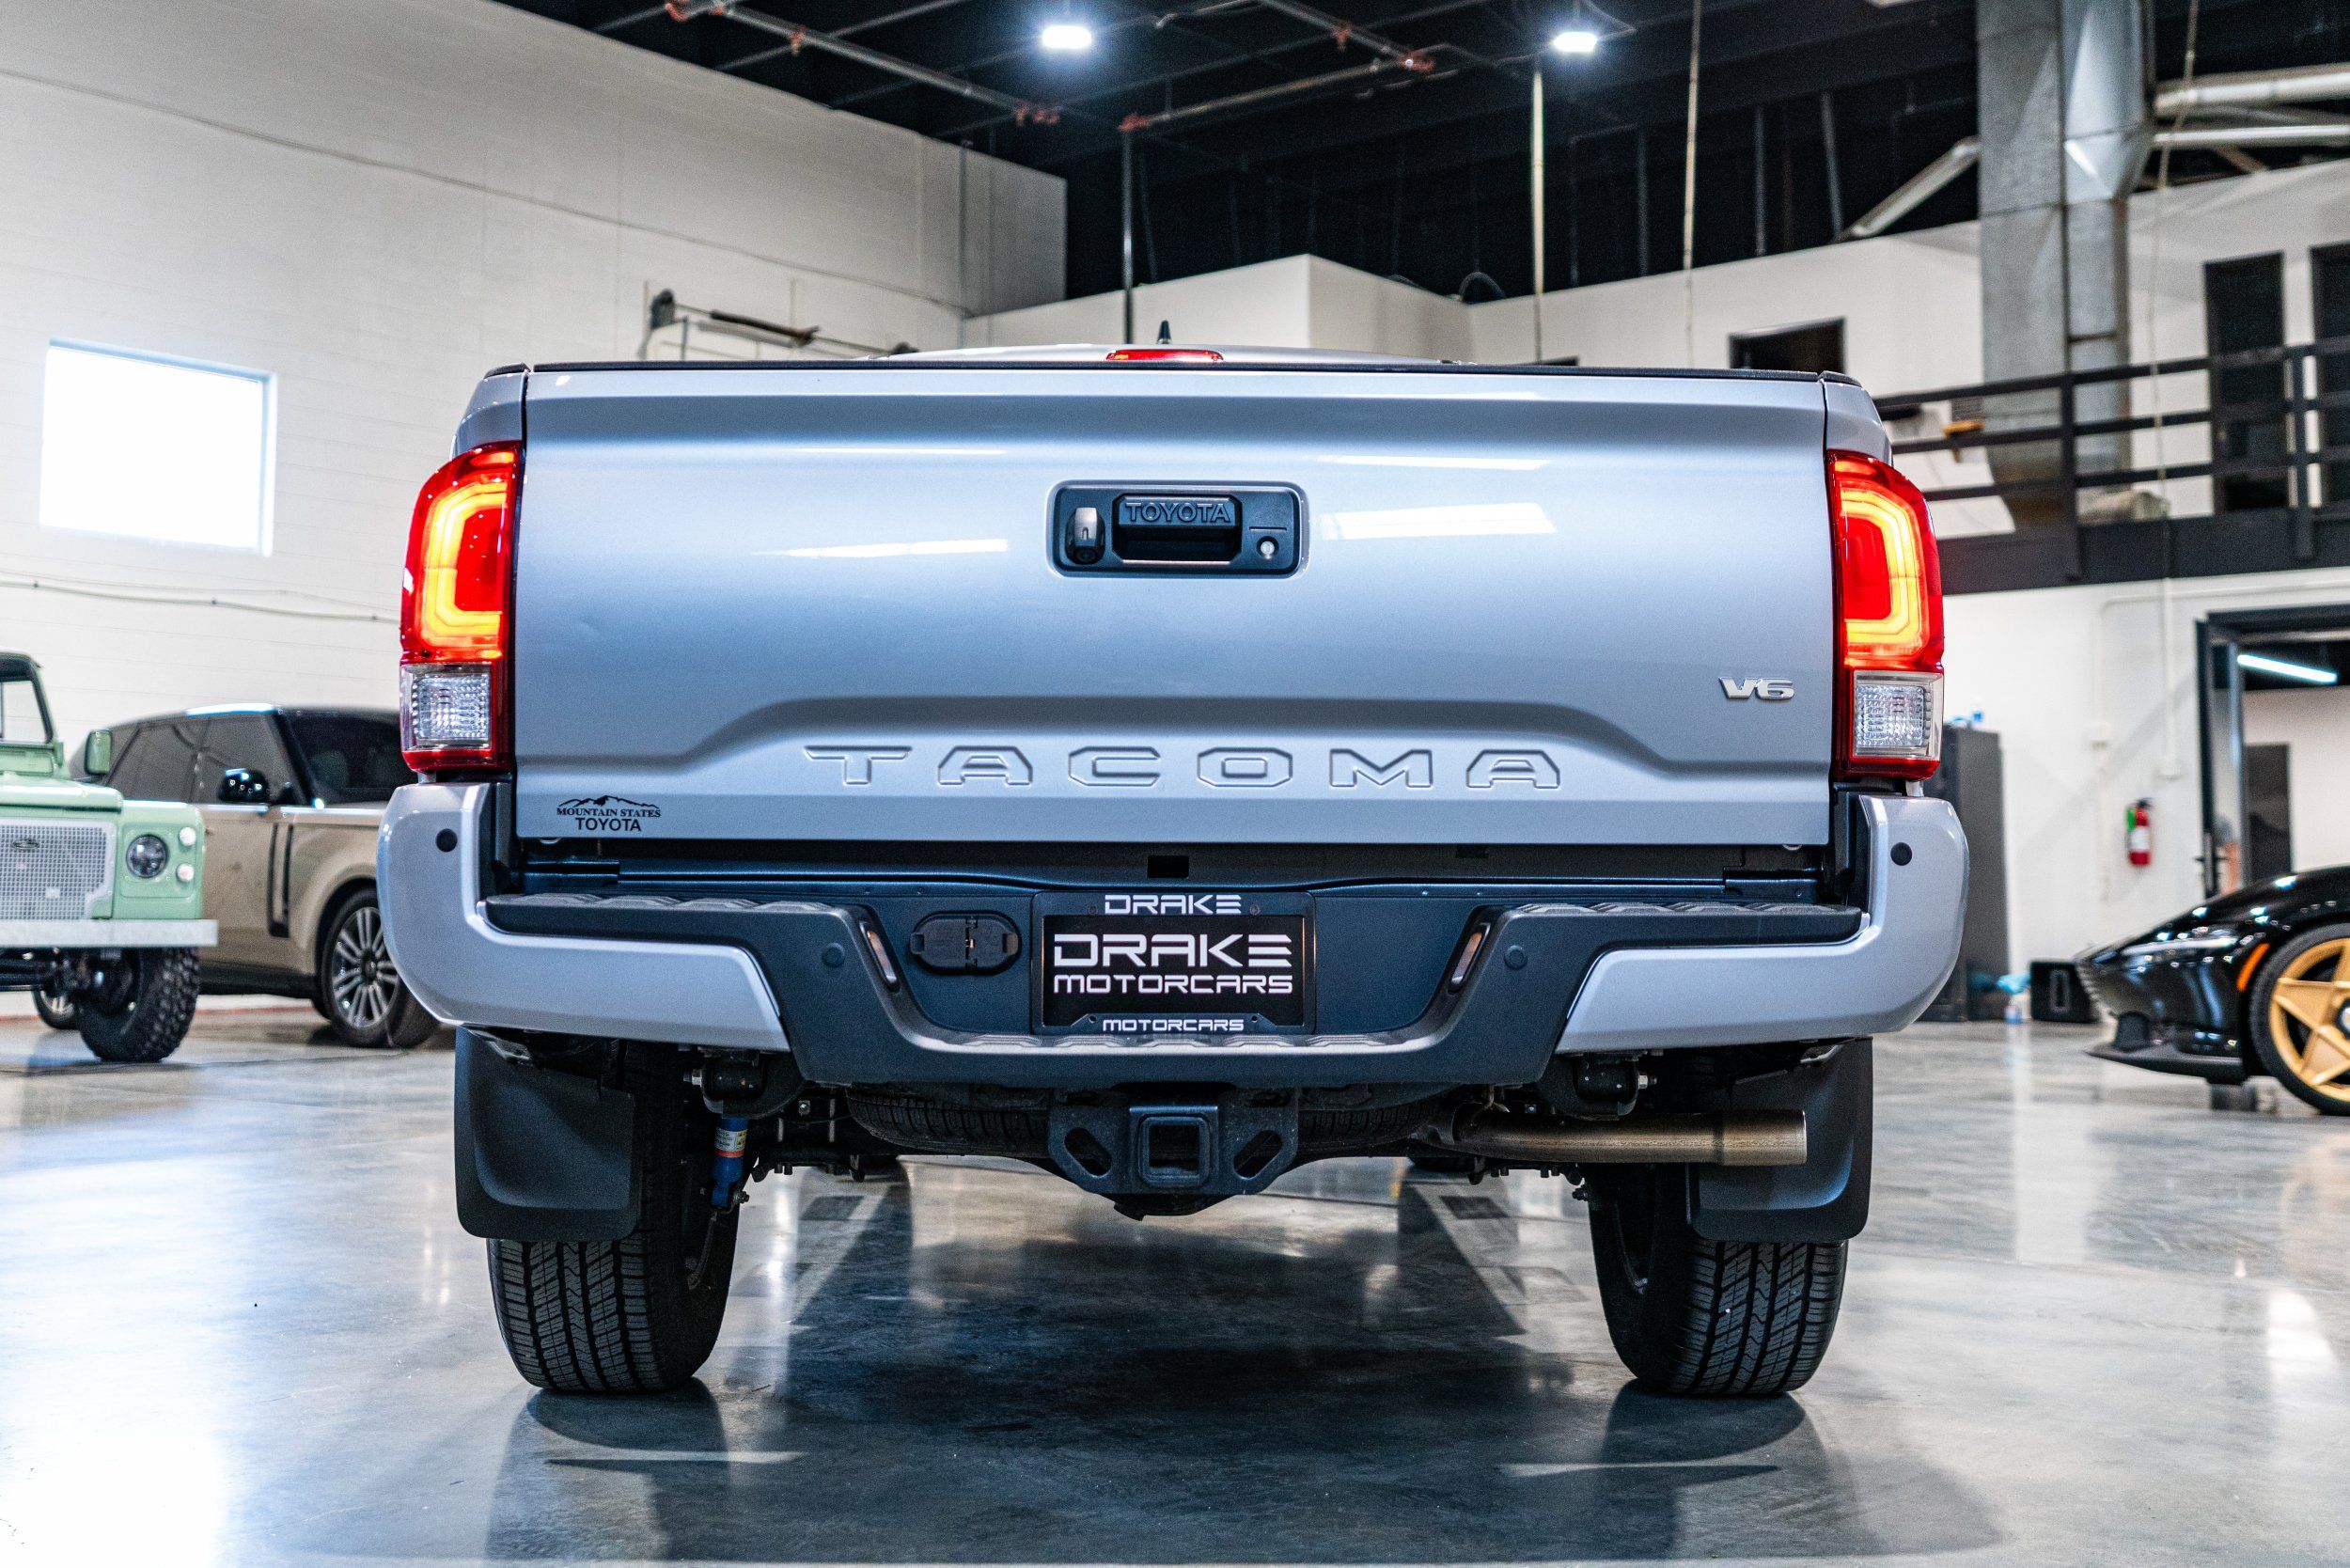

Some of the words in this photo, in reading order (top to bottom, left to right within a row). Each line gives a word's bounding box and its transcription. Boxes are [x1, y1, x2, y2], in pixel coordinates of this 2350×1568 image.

[1124, 501, 1231, 524] TOYOTA
[1717, 677, 1795, 700] V6
[804, 745, 1560, 788] TACOMA
[556, 808, 618, 817] MOUNTAIN
[619, 809, 661, 818] STATES
[575, 817, 642, 832] TOYOTA
[1104, 894, 1242, 915] DRAKE
[1053, 933, 1292, 967] DRAKE
[1053, 974, 1293, 994] MOTORCARS
[1103, 1018, 1245, 1031] MOTORCARS
